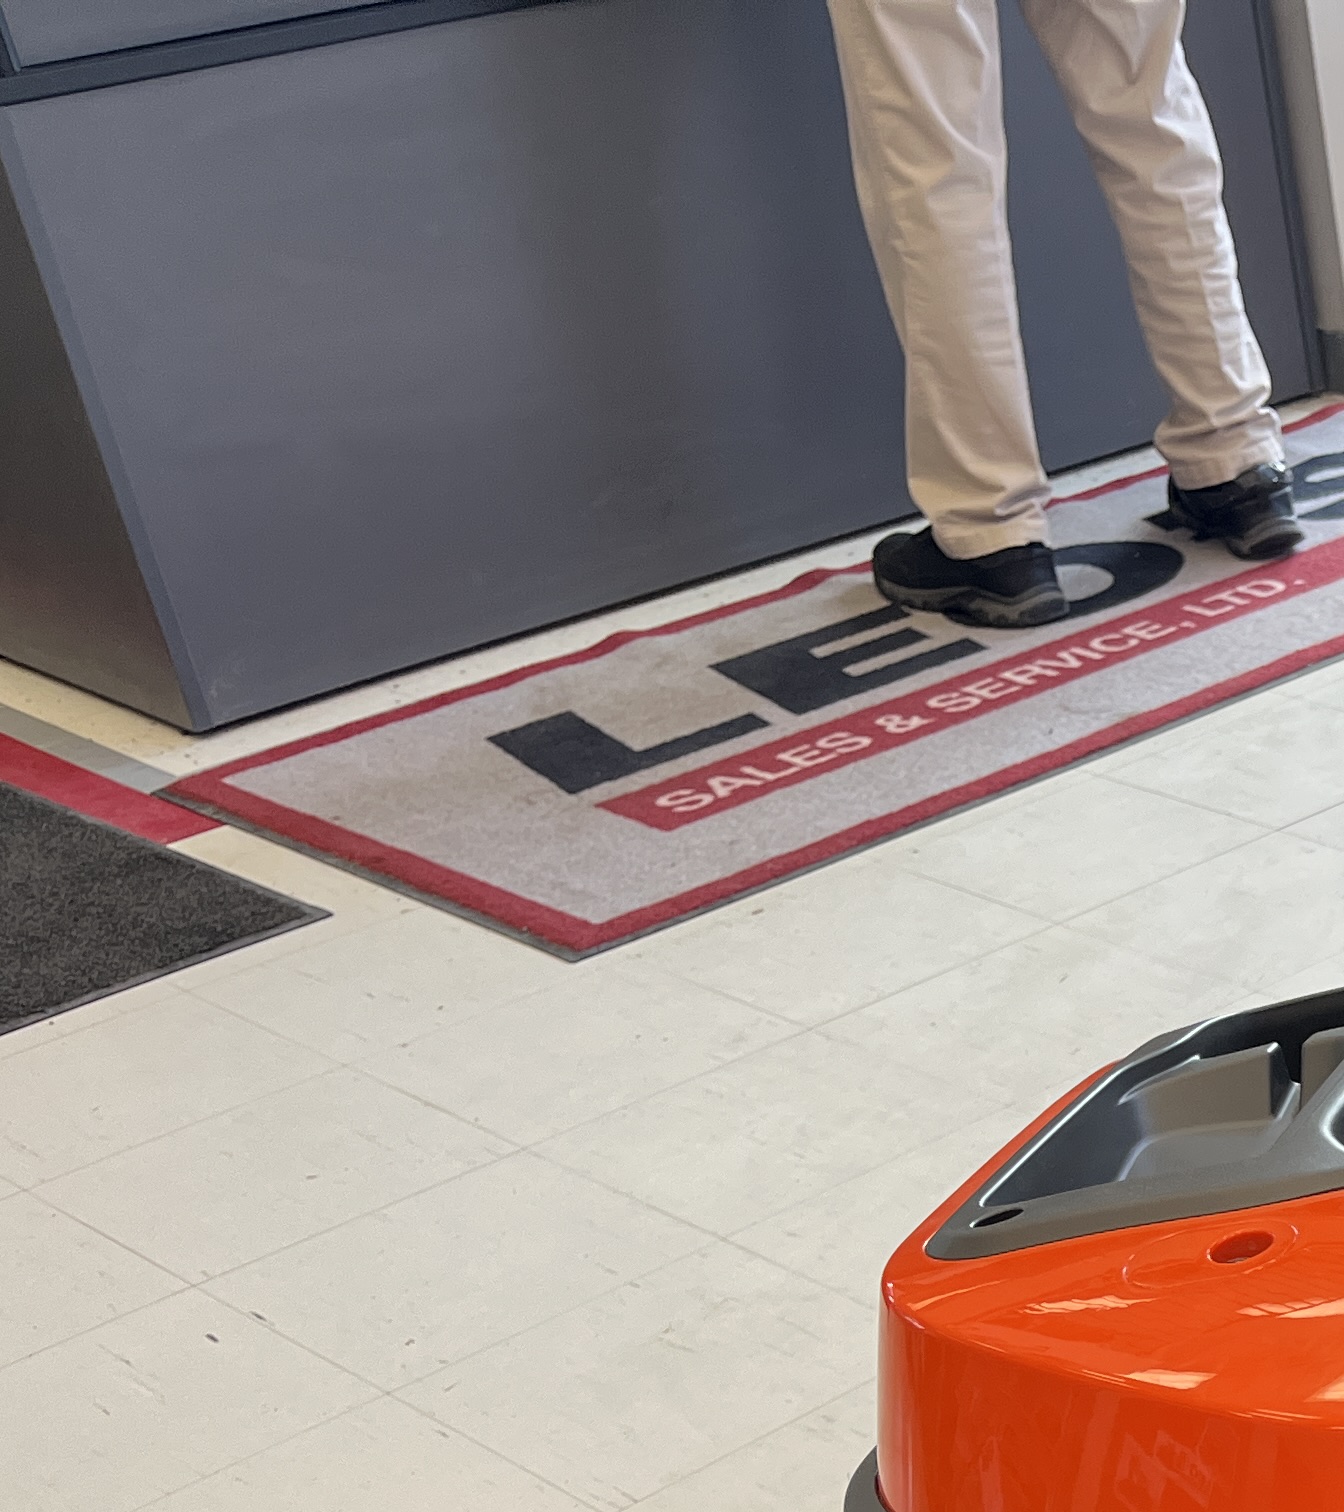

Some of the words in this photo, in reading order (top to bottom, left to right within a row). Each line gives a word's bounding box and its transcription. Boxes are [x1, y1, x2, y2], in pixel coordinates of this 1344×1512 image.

[654, 730, 874, 813] SALES
[874, 712, 936, 735] &
[925, 618, 1197, 714] SERVICE,
[1187, 577, 1306, 619] LTD.
